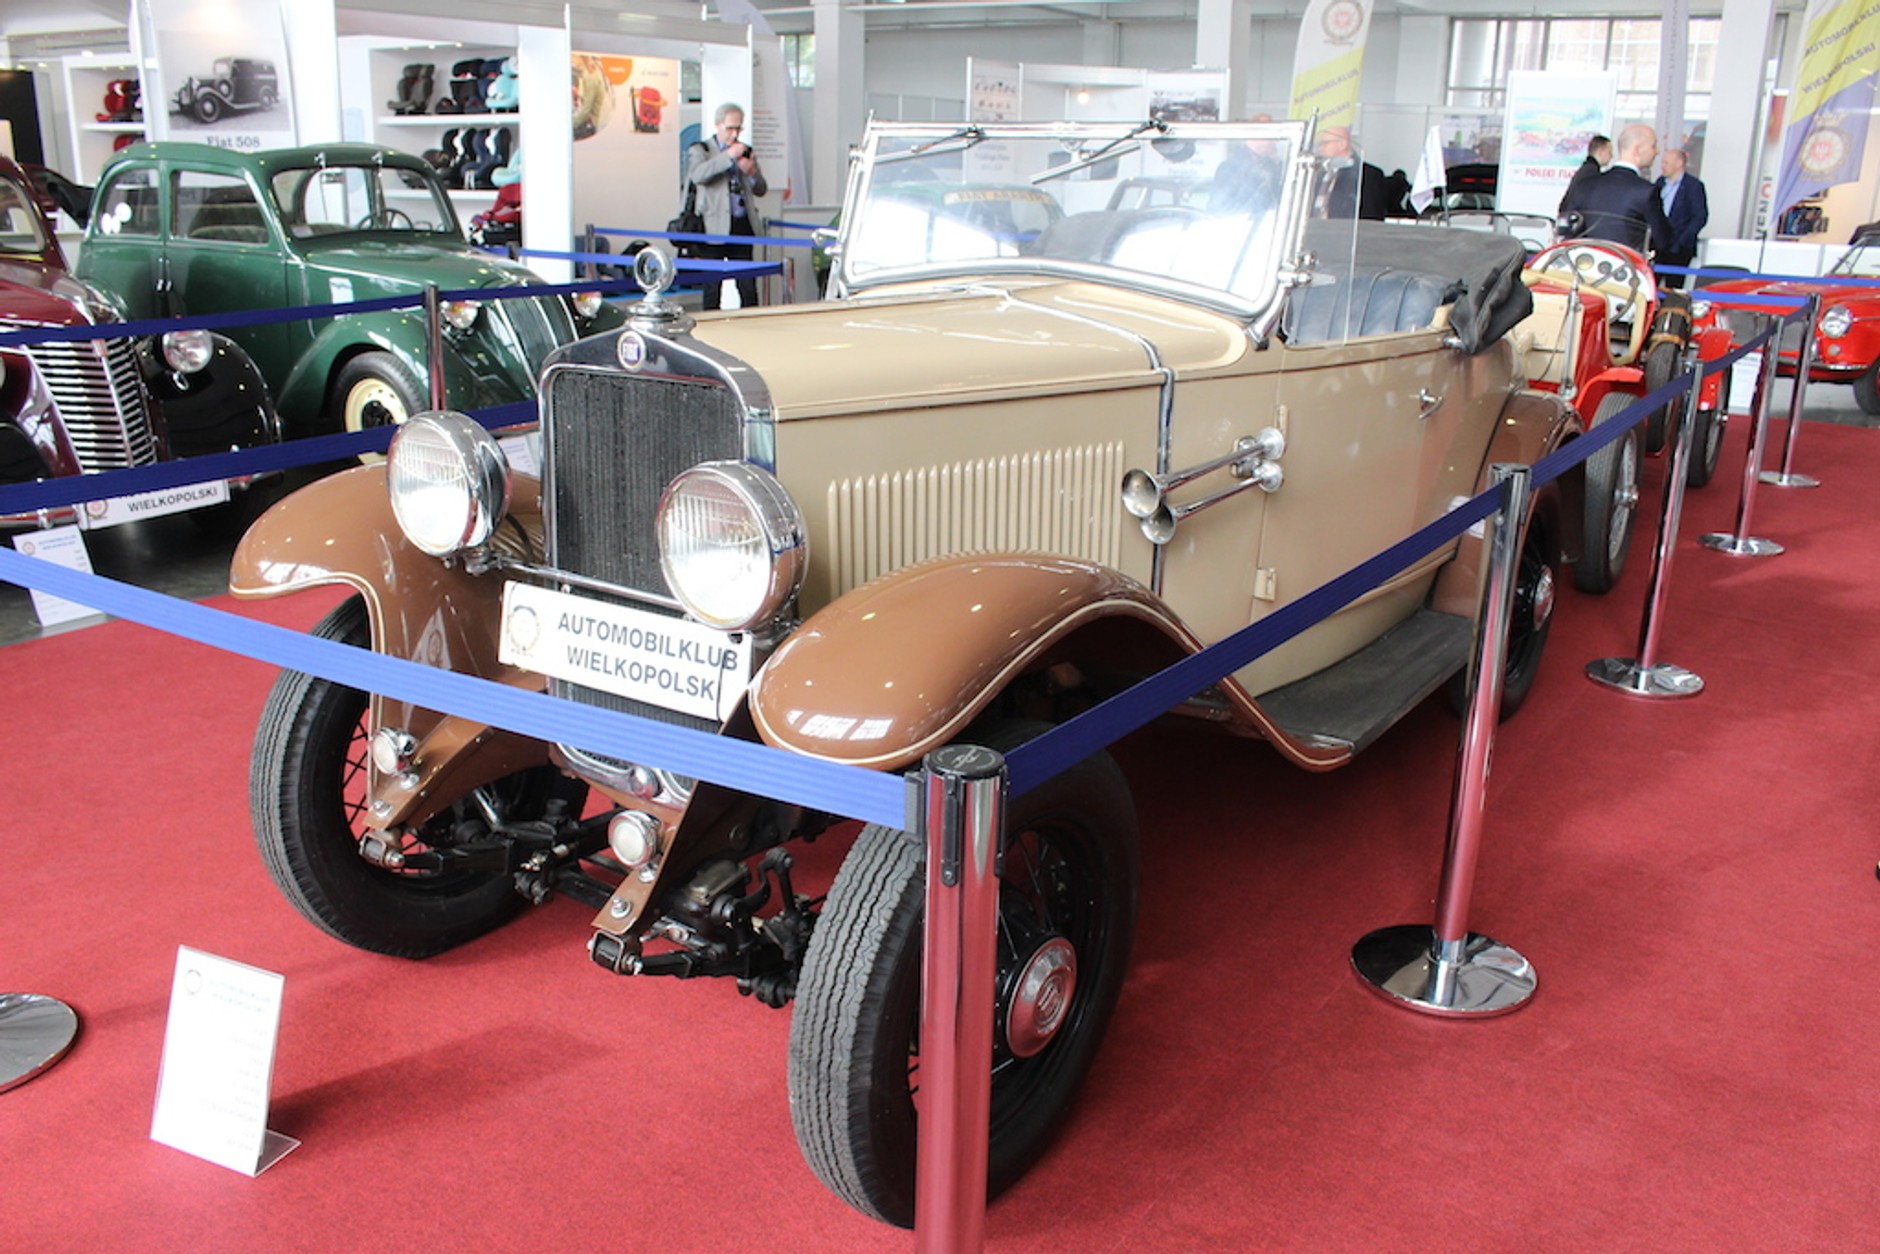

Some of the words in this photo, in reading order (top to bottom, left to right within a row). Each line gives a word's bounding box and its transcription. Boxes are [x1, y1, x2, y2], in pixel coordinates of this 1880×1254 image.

[235, 136, 260, 148] 508
[1525, 168, 1555, 177] POLSKI
[127, 487, 218, 512] WIELKOPOLSKI
[558, 612, 738, 671] AUTOMOBILKLUB
[567, 645, 717, 701] WIELKOPOLSK
